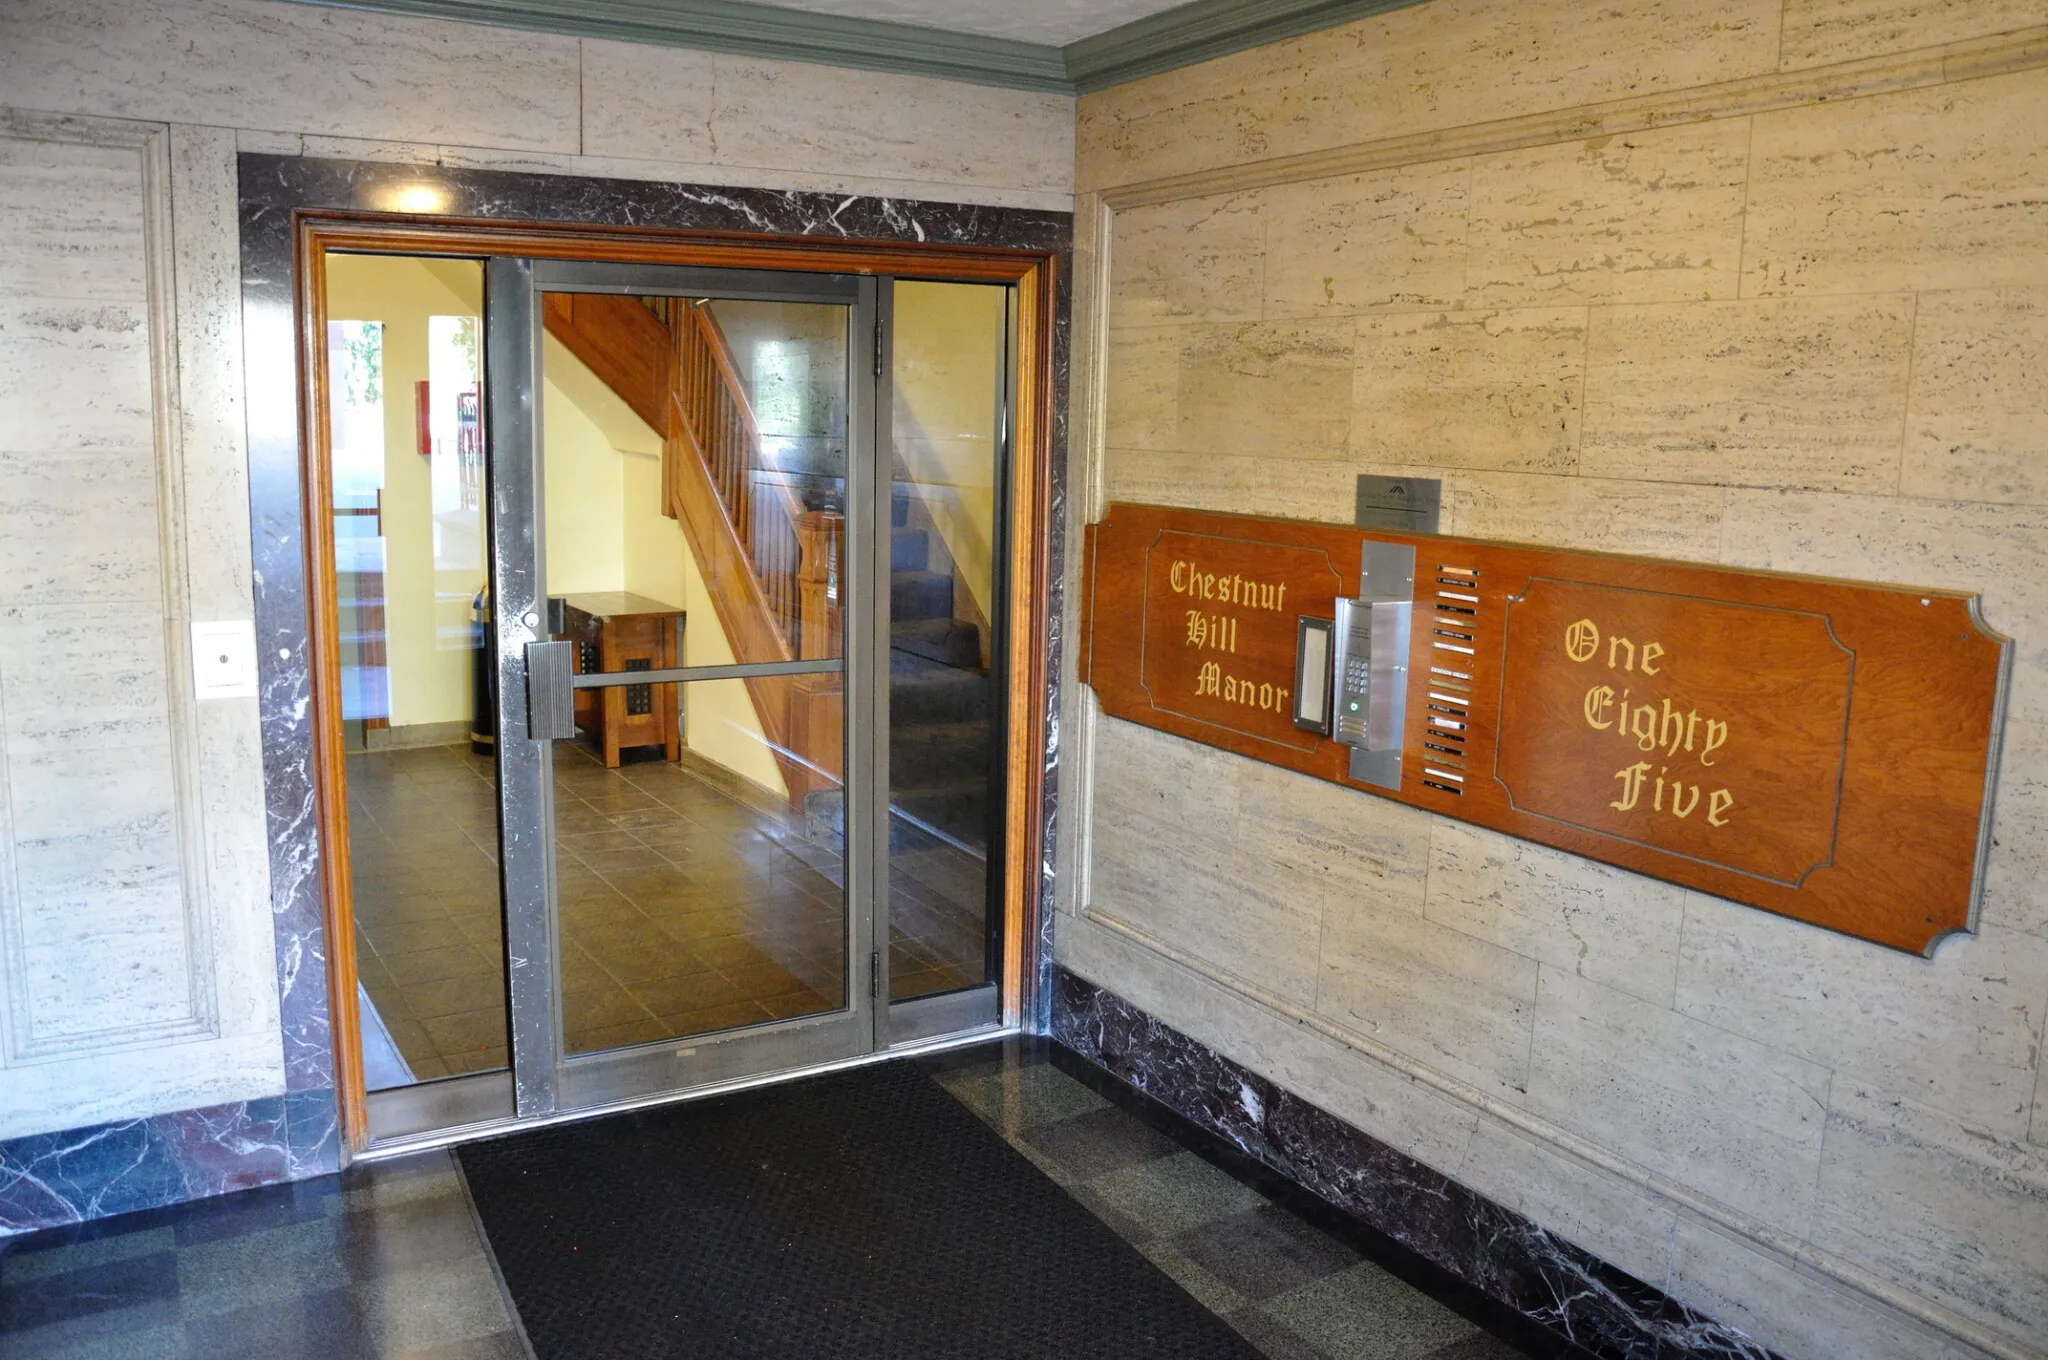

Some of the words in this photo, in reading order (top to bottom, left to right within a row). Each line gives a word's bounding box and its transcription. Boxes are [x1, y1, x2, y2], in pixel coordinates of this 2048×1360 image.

[1169, 560, 1287, 612] Chestnut
[1185, 610, 1237, 654] Hill
[1565, 618, 1665, 676] One
[1195, 662, 1290, 714] Manor
[1584, 685, 1728, 767] Eighty
[1610, 761, 1734, 828] Five
